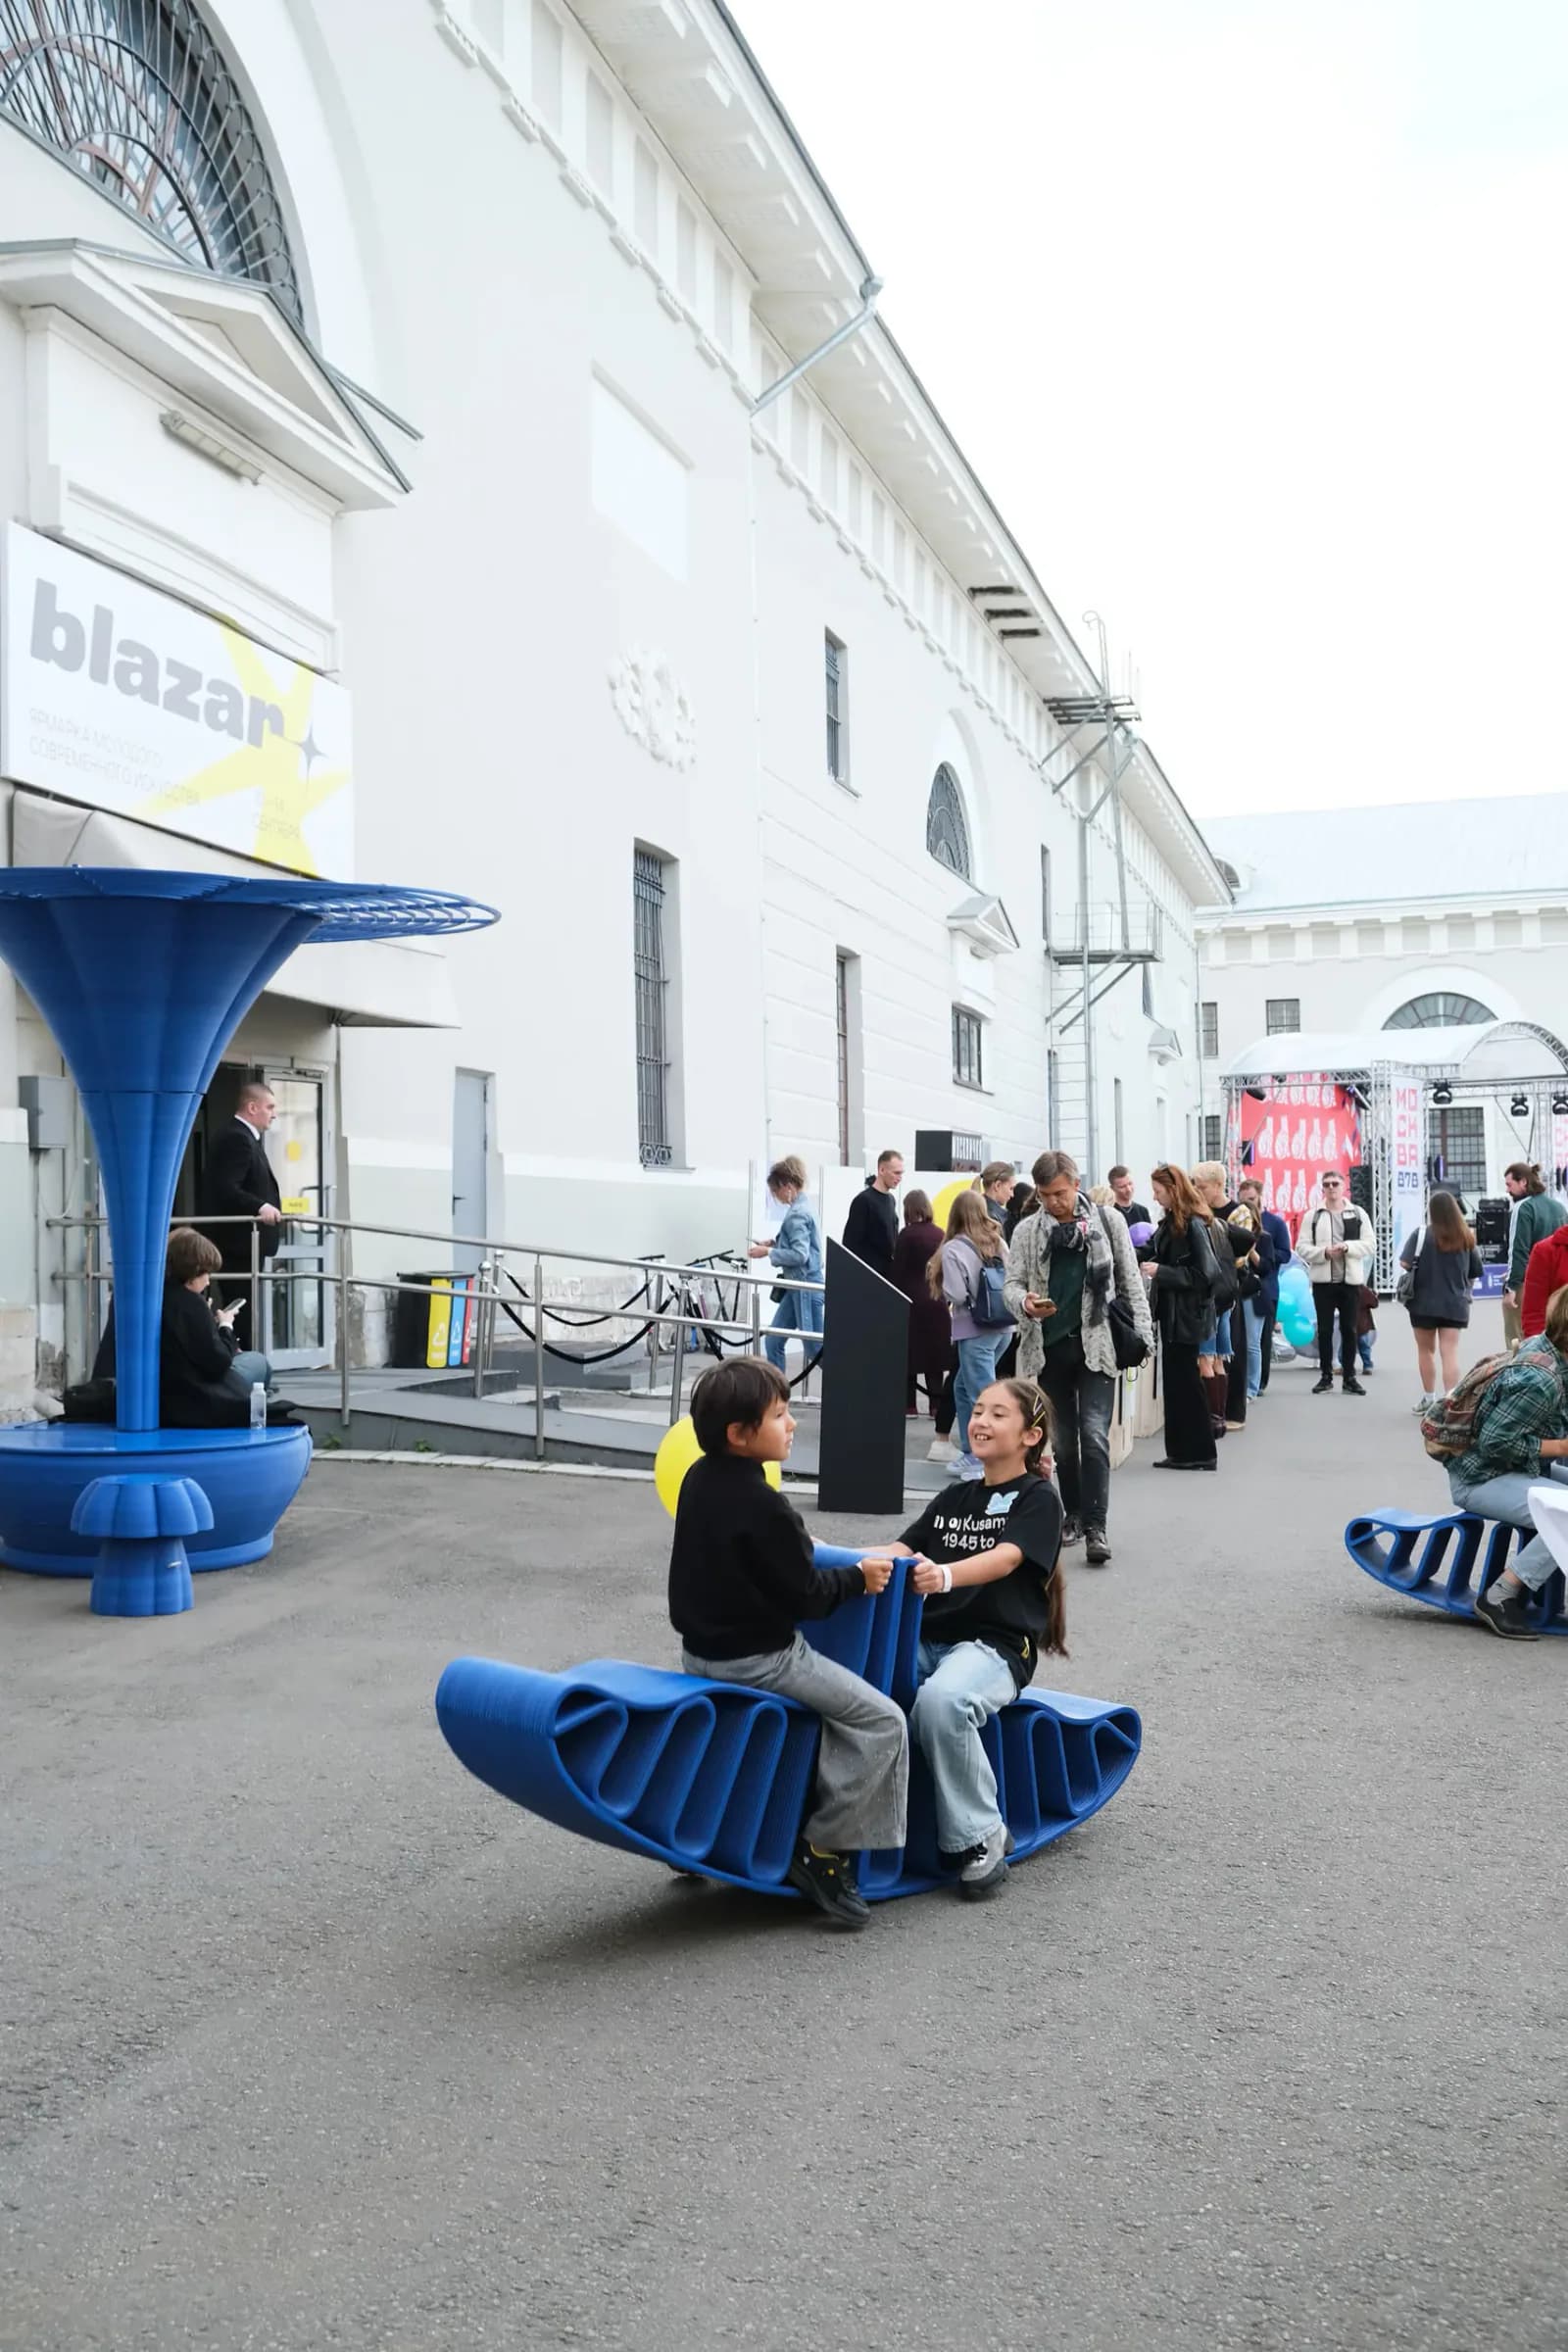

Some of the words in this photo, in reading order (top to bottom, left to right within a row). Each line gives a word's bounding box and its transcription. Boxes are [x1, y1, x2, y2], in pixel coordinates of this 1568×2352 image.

[30, 578, 284, 749] blazar
[963, 1514, 1008, 1531] Kusam
[942, 1532, 978, 1550] 1945
[980, 1535, 996, 1549] to
